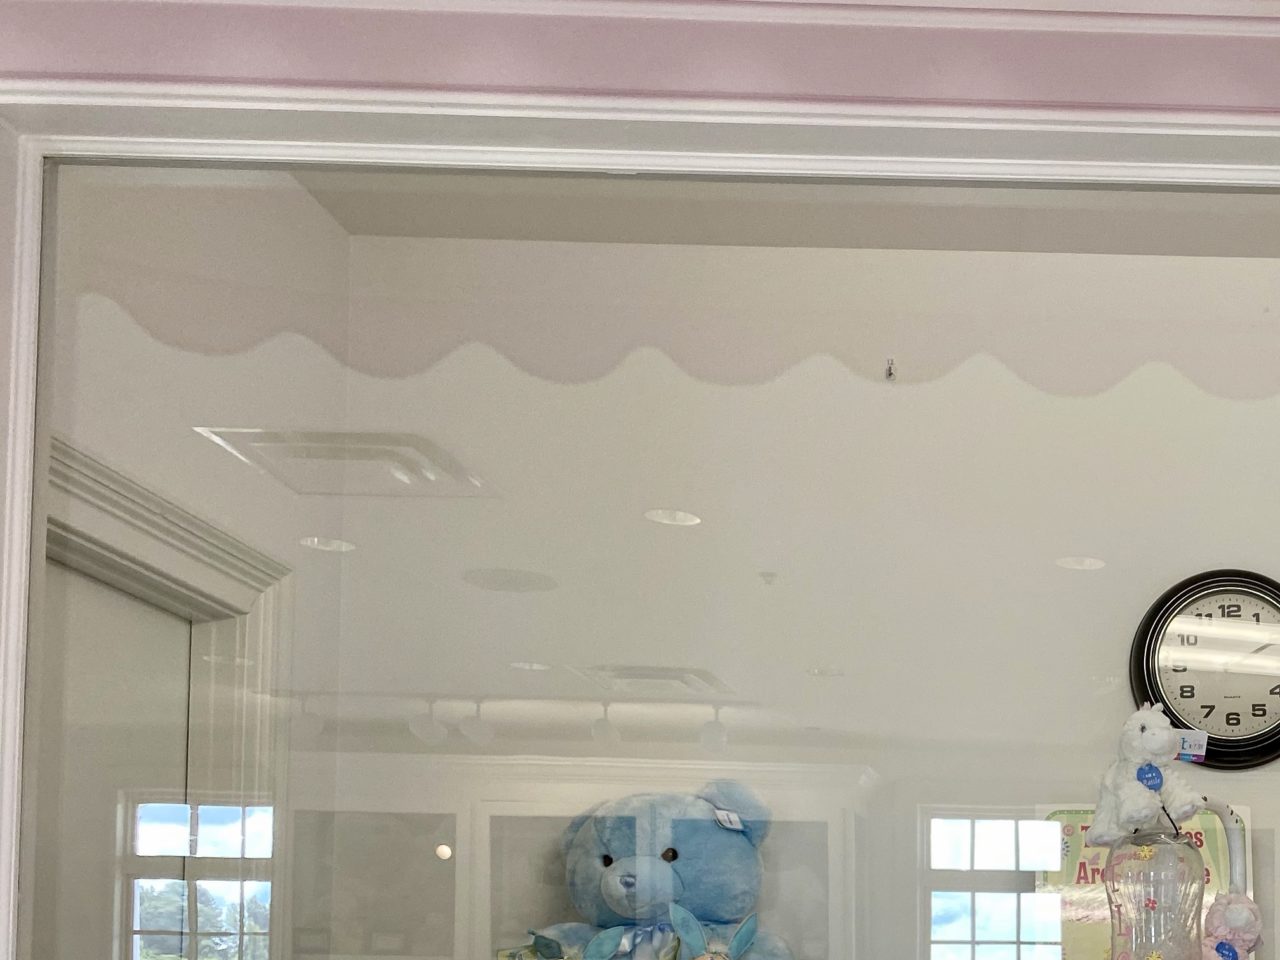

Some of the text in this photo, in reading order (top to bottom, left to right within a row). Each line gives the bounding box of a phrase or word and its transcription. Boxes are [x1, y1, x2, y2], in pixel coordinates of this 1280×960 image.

[1218, 604, 1242, 618] 12
[1177, 633, 1198, 646] 10
[1179, 685, 1195, 698] 8
[1200, 705, 1215, 718] 7
[1252, 704, 1267, 717] 5
[1225, 713, 1241, 726] 6
